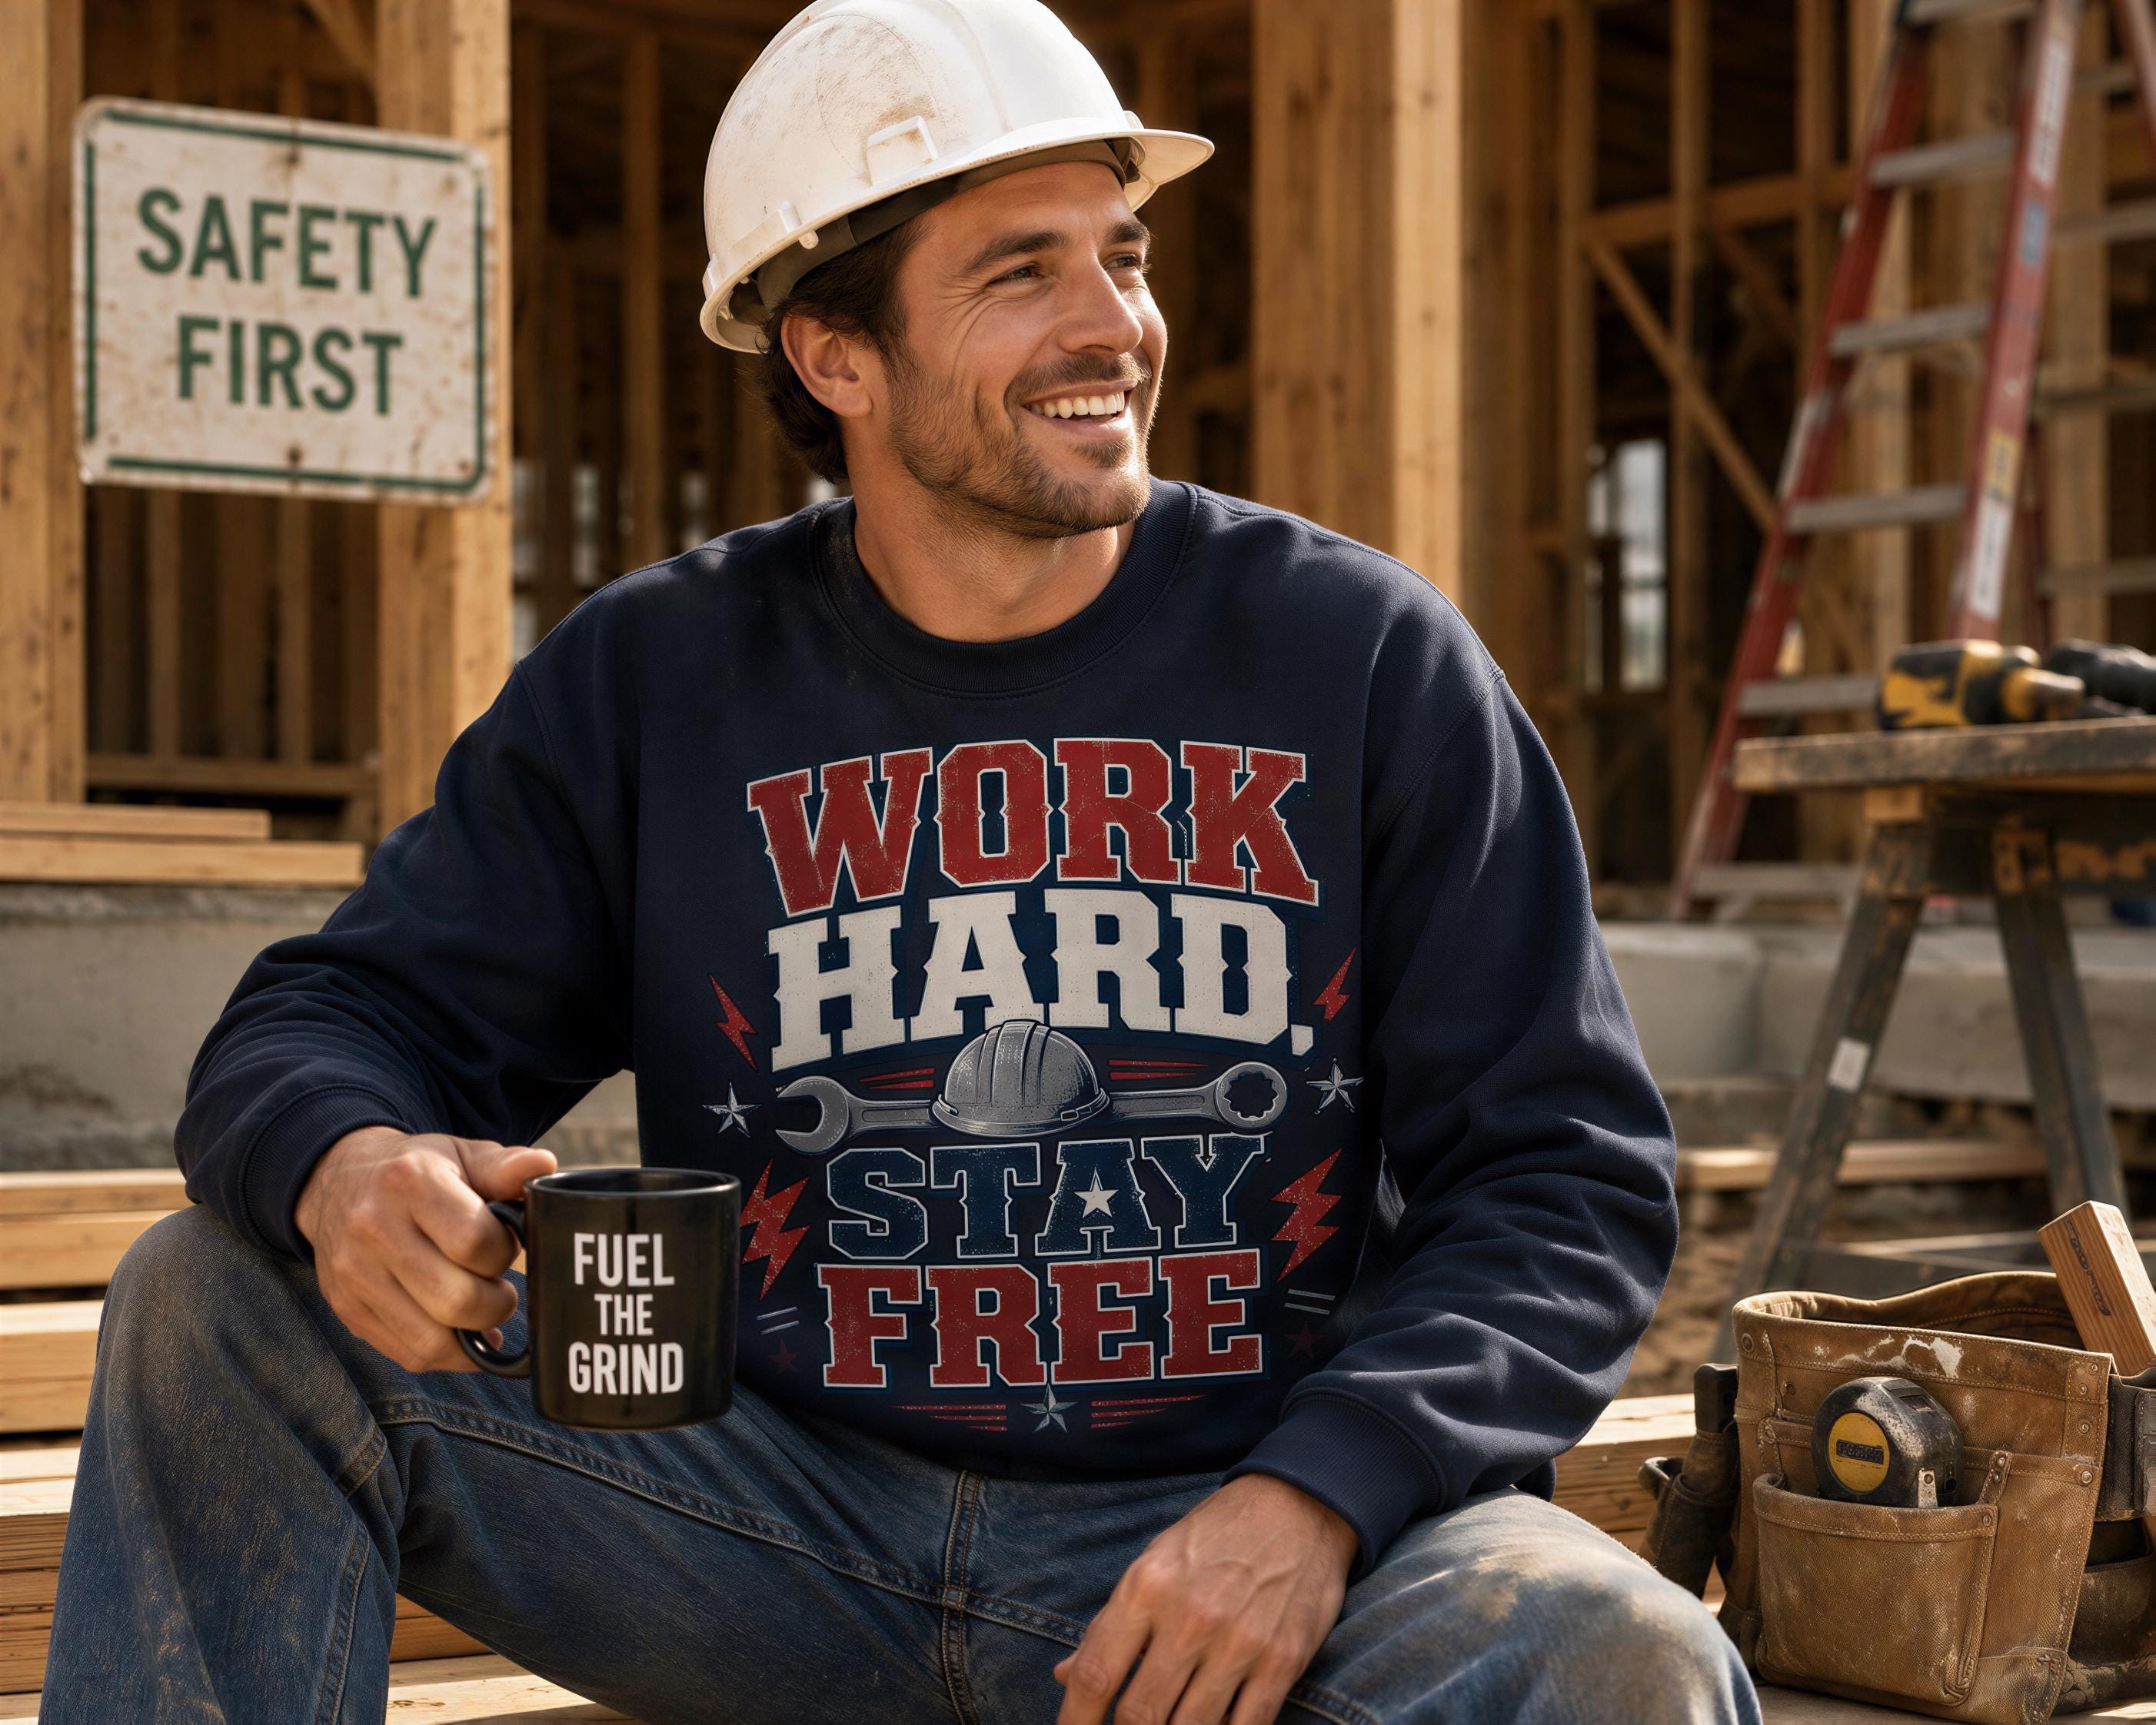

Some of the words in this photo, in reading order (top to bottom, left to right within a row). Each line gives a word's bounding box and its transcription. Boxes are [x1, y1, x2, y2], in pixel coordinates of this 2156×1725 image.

[137, 188, 438, 299] SAFETY
[176, 314, 404, 417] FIRST
[746, 737, 1320, 919] WORK
[826, 1135, 1265, 1260] STAY
[574, 1232, 675, 1287] FUEL
[568, 1341, 684, 1395] GRIND
[594, 1293, 654, 1336] THE
[817, 1248, 1264, 1388] FREE
